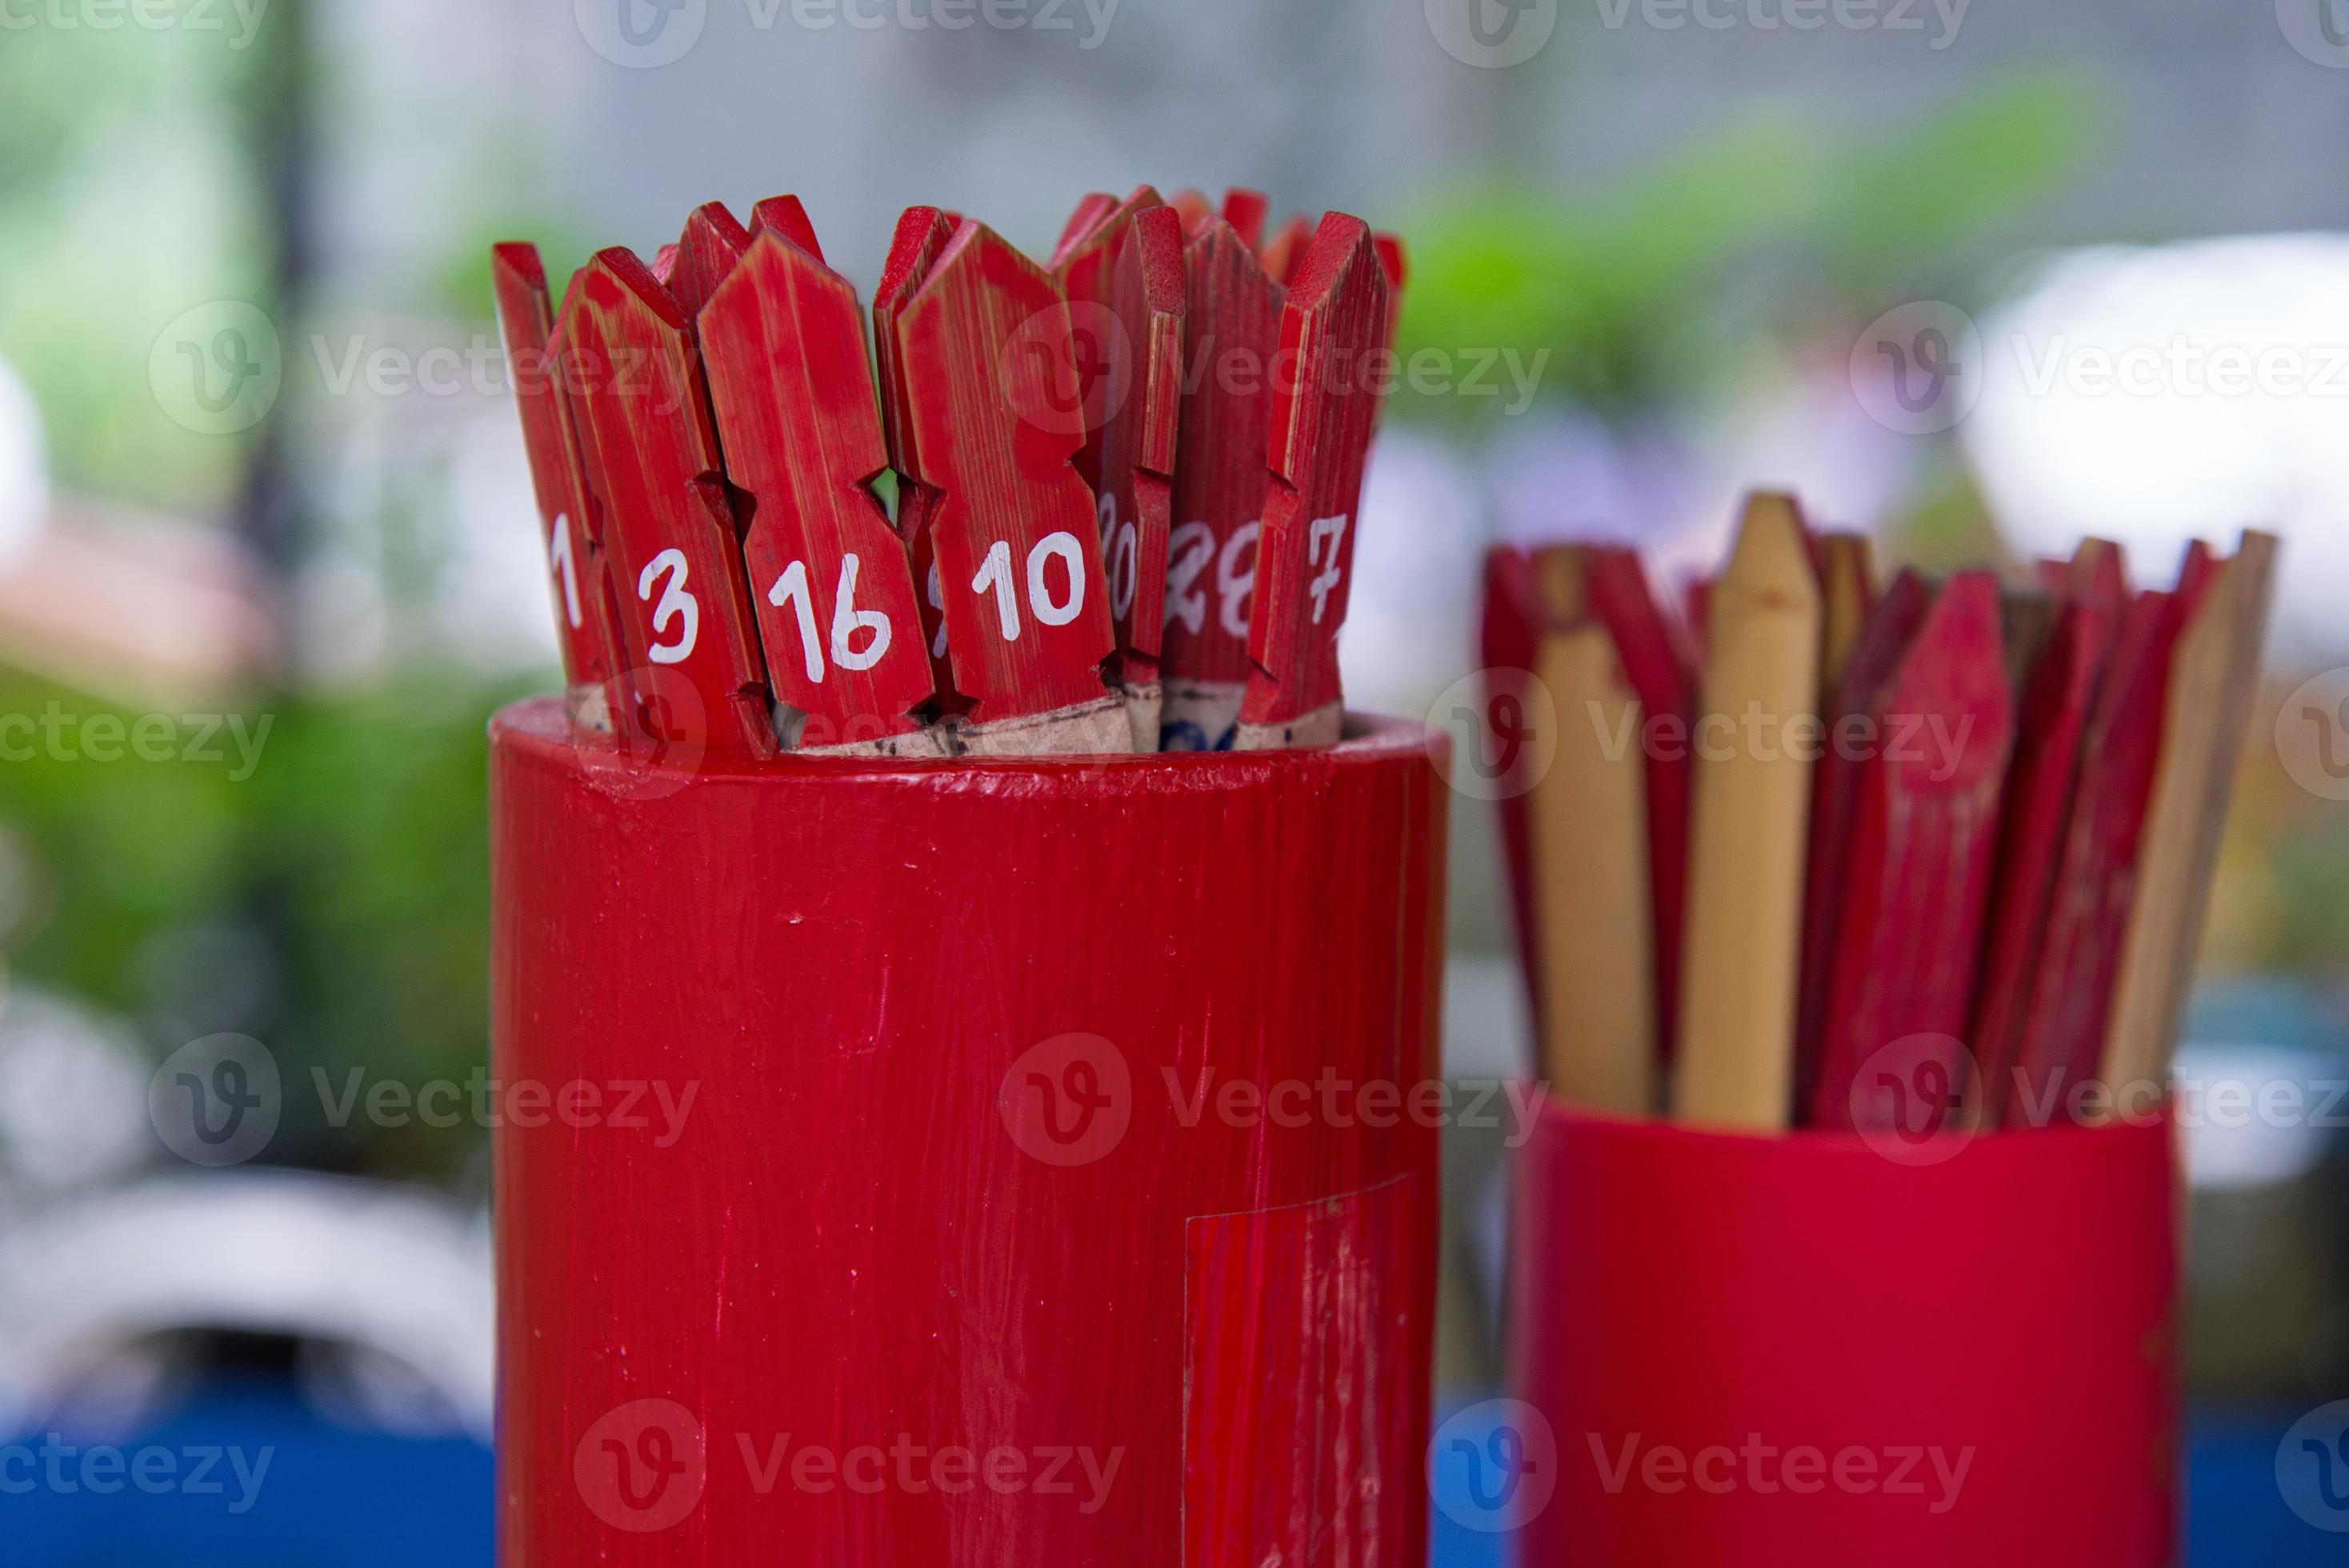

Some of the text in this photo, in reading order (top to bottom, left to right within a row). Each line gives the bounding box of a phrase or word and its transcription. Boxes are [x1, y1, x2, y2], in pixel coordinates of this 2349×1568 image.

[550, 512, 582, 630] 1
[638, 548, 698, 664] 3
[767, 552, 892, 683] 16
[971, 531, 1086, 641] 10
[1310, 513, 1347, 625] 7
